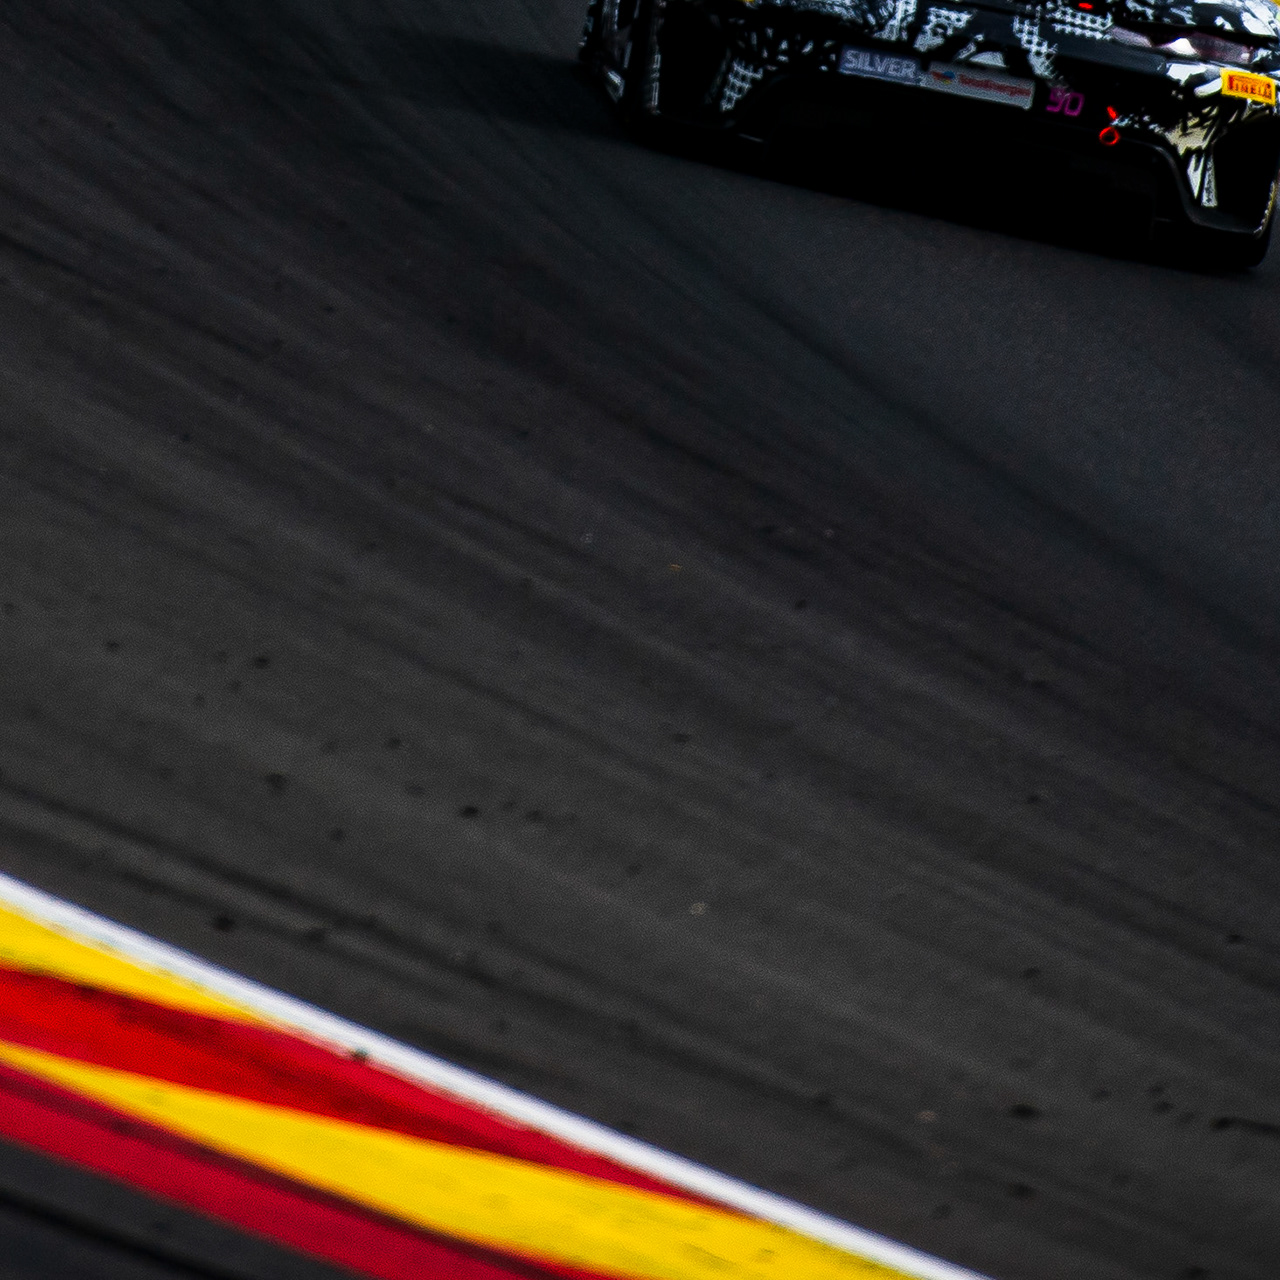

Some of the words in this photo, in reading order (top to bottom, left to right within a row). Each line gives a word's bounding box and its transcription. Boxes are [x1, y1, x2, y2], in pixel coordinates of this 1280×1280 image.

[844, 49, 918, 79] SILVER
[1044, 86, 1086, 117] 90
[1227, 73, 1273, 100] PIRELLI
